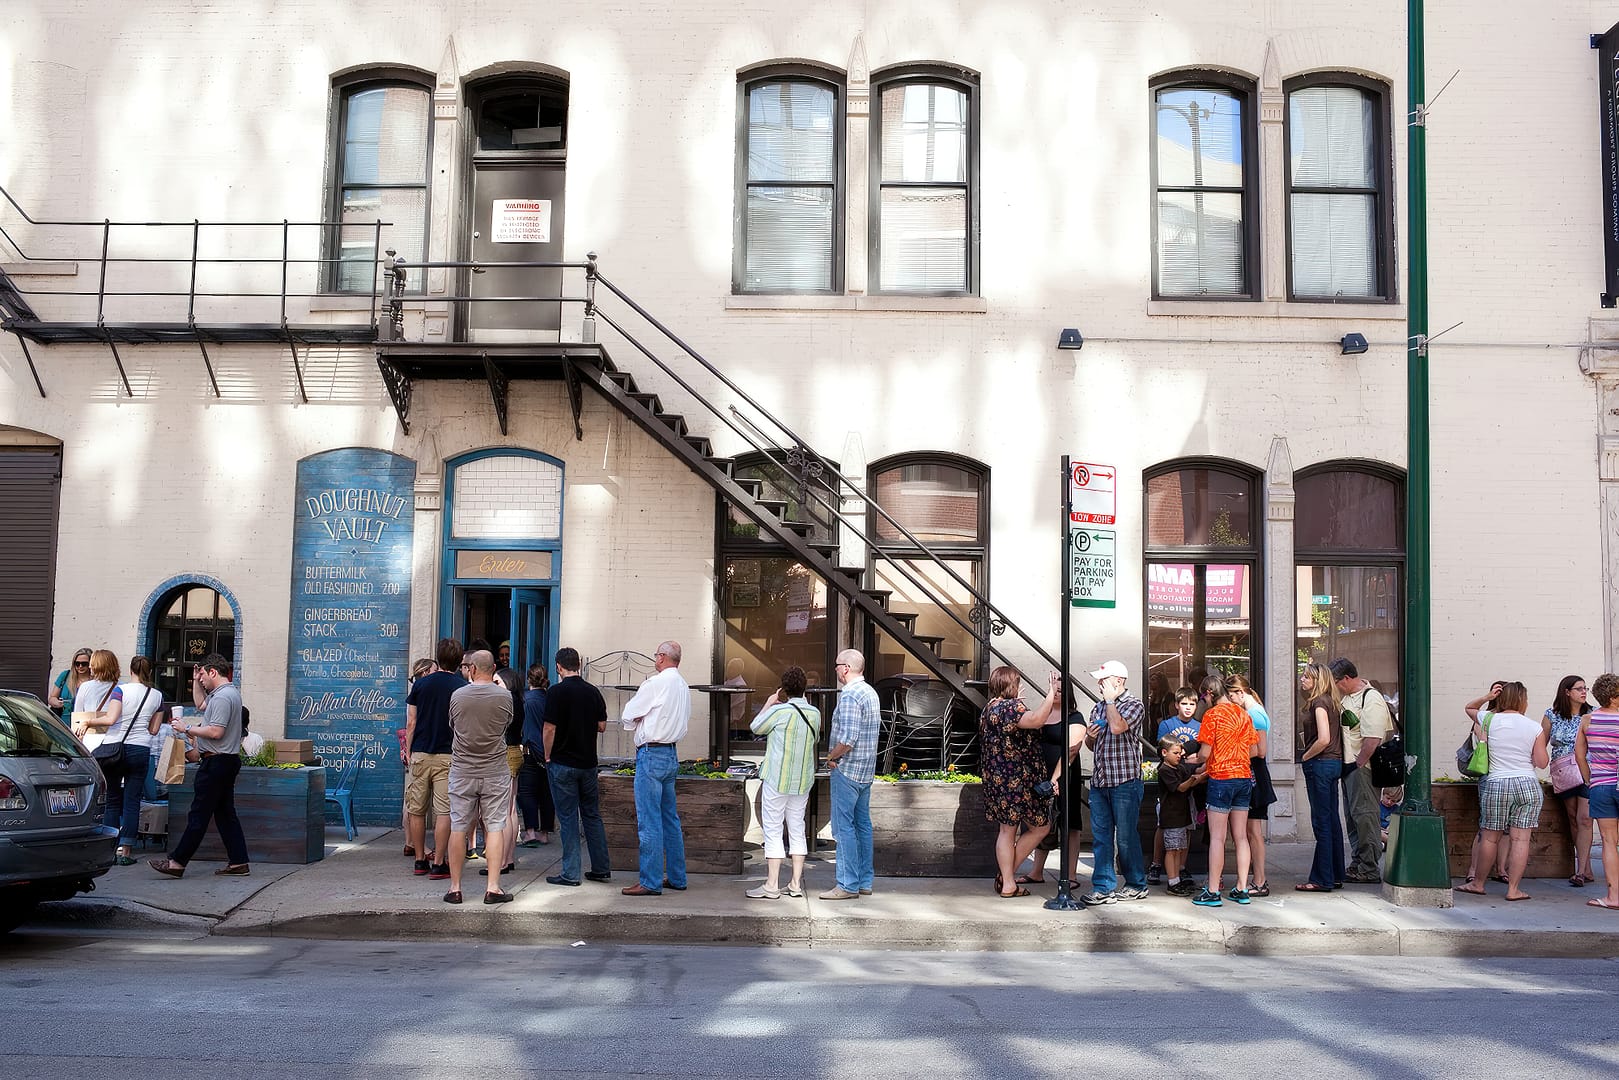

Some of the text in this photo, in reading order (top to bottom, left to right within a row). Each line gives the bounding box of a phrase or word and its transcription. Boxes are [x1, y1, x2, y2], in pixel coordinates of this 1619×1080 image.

[305, 488, 408, 520] DOUGHNUT
[1073, 512, 1113, 524] TOW ZONE
[322, 517, 389, 544] VAULT
[479, 554, 528, 573] Enter
[1073, 556, 1112, 568] PAY FOR
[305, 566, 367, 580] BUTTERMILK
[1073, 566, 1114, 578] PARKING
[304, 581, 323, 595] OLD
[323, 581, 374, 595] FASHIONED
[1073, 576, 1106, 588] AT PAY
[1073, 586, 1093, 597] BOX
[304, 607, 372, 621] GINGERBREAD
[303, 623, 337, 637] STACK
[189, 639, 207, 648] CASH
[302, 648, 342, 662] GLAZED
[300, 687, 397, 721] Dollar Coffee
[317, 732, 335, 741] NOW
[312, 741, 357, 755] easonal
